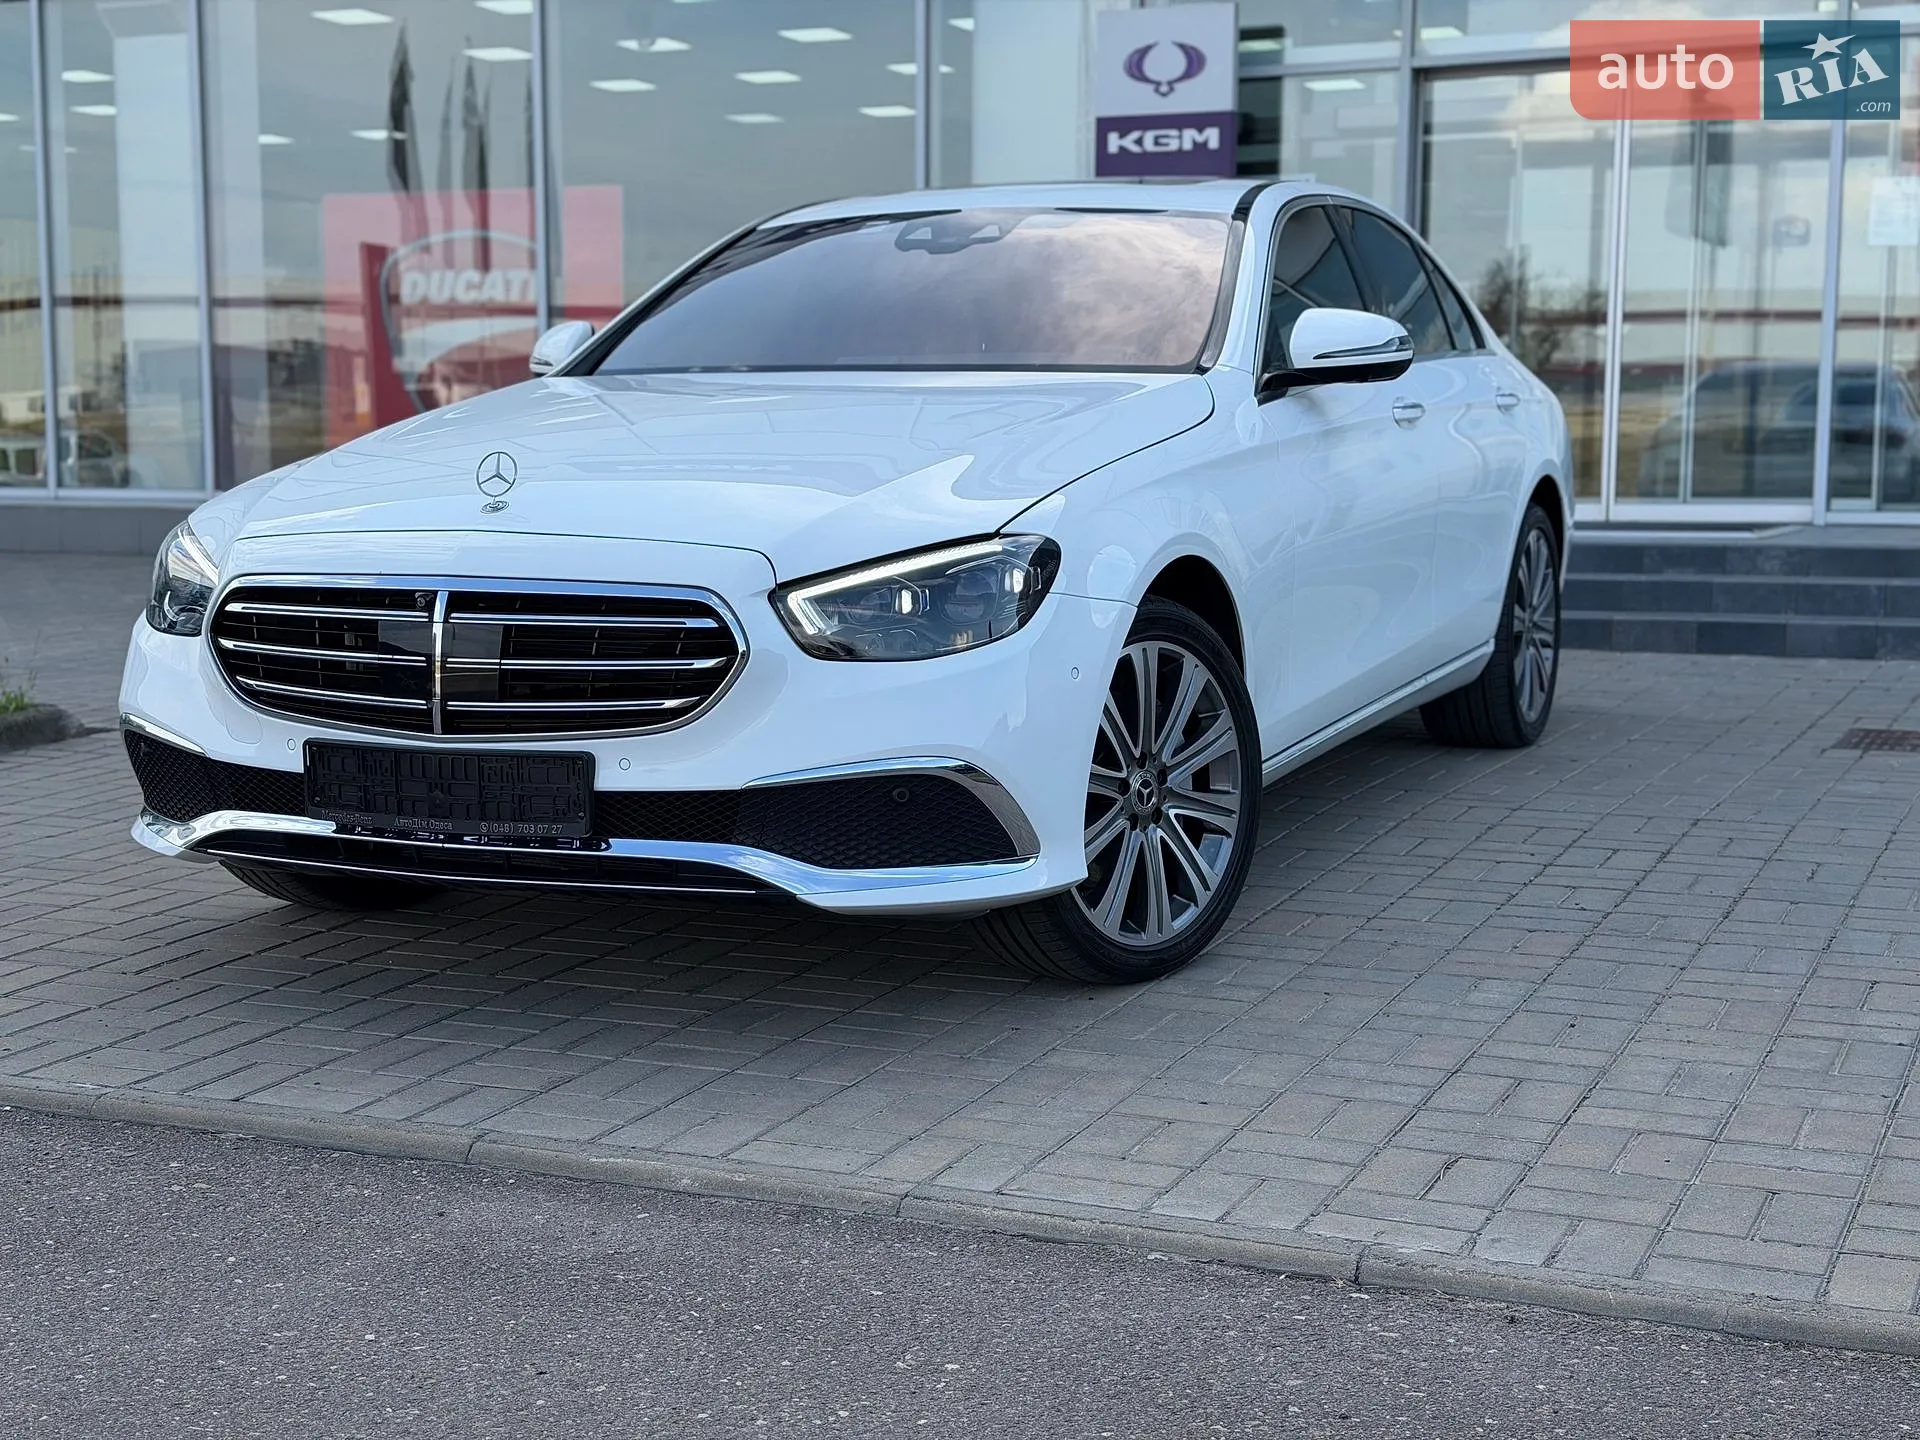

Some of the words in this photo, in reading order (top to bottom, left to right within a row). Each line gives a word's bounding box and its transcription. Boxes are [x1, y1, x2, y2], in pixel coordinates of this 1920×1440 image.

[1106, 126, 1220, 155] KGM
[518, 823, 535, 834] 703
[537, 823, 549, 834] 07
[551, 824, 563, 834] 27
